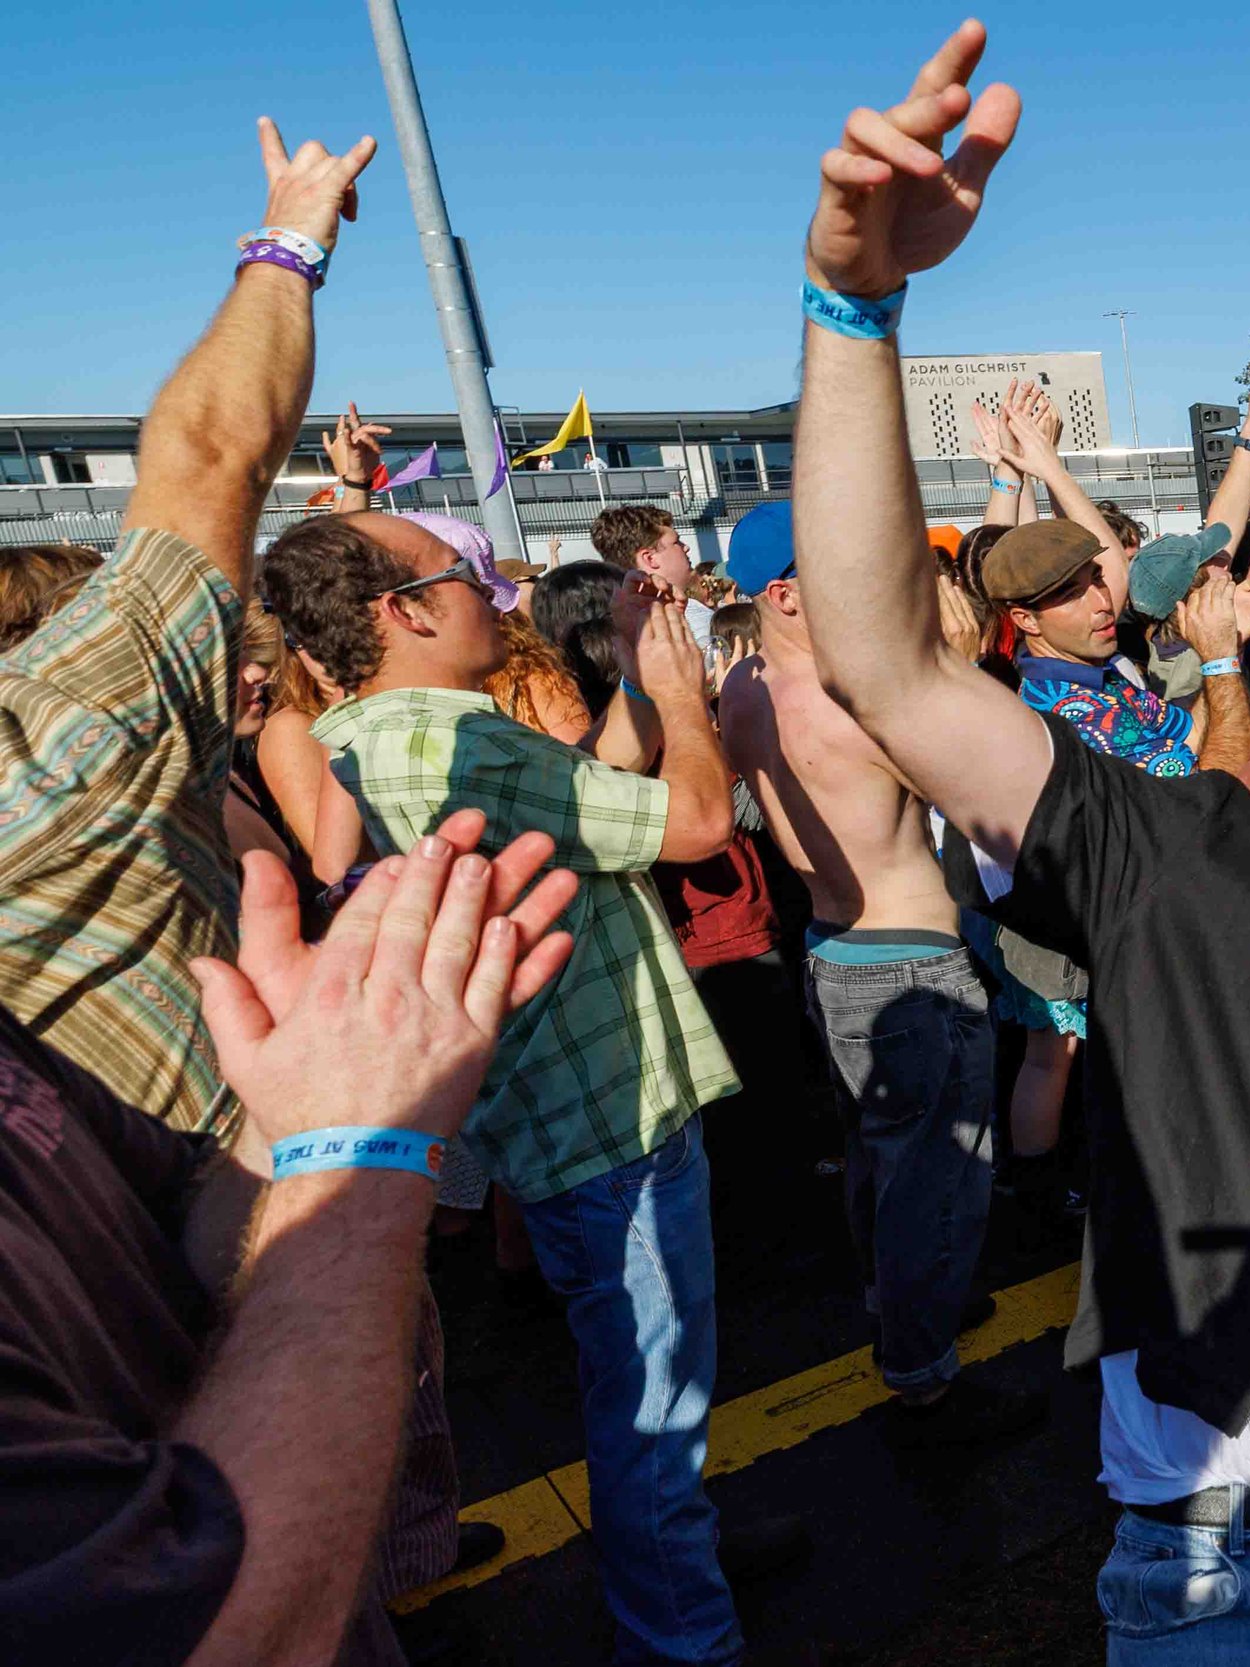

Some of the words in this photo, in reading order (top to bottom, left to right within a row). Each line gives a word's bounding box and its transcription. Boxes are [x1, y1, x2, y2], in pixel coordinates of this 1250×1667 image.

[815, 301, 844, 321] THE
[909, 364, 949, 375] ADAM
[954, 362, 1027, 374] GILCHRIST
[909, 375, 976, 387] PAVILION
[285, 1143, 314, 1163] THE
[320, 1139, 345, 1155] AT
[353, 1139, 398, 1156] WAS
[402, 1143, 411, 1157] I
